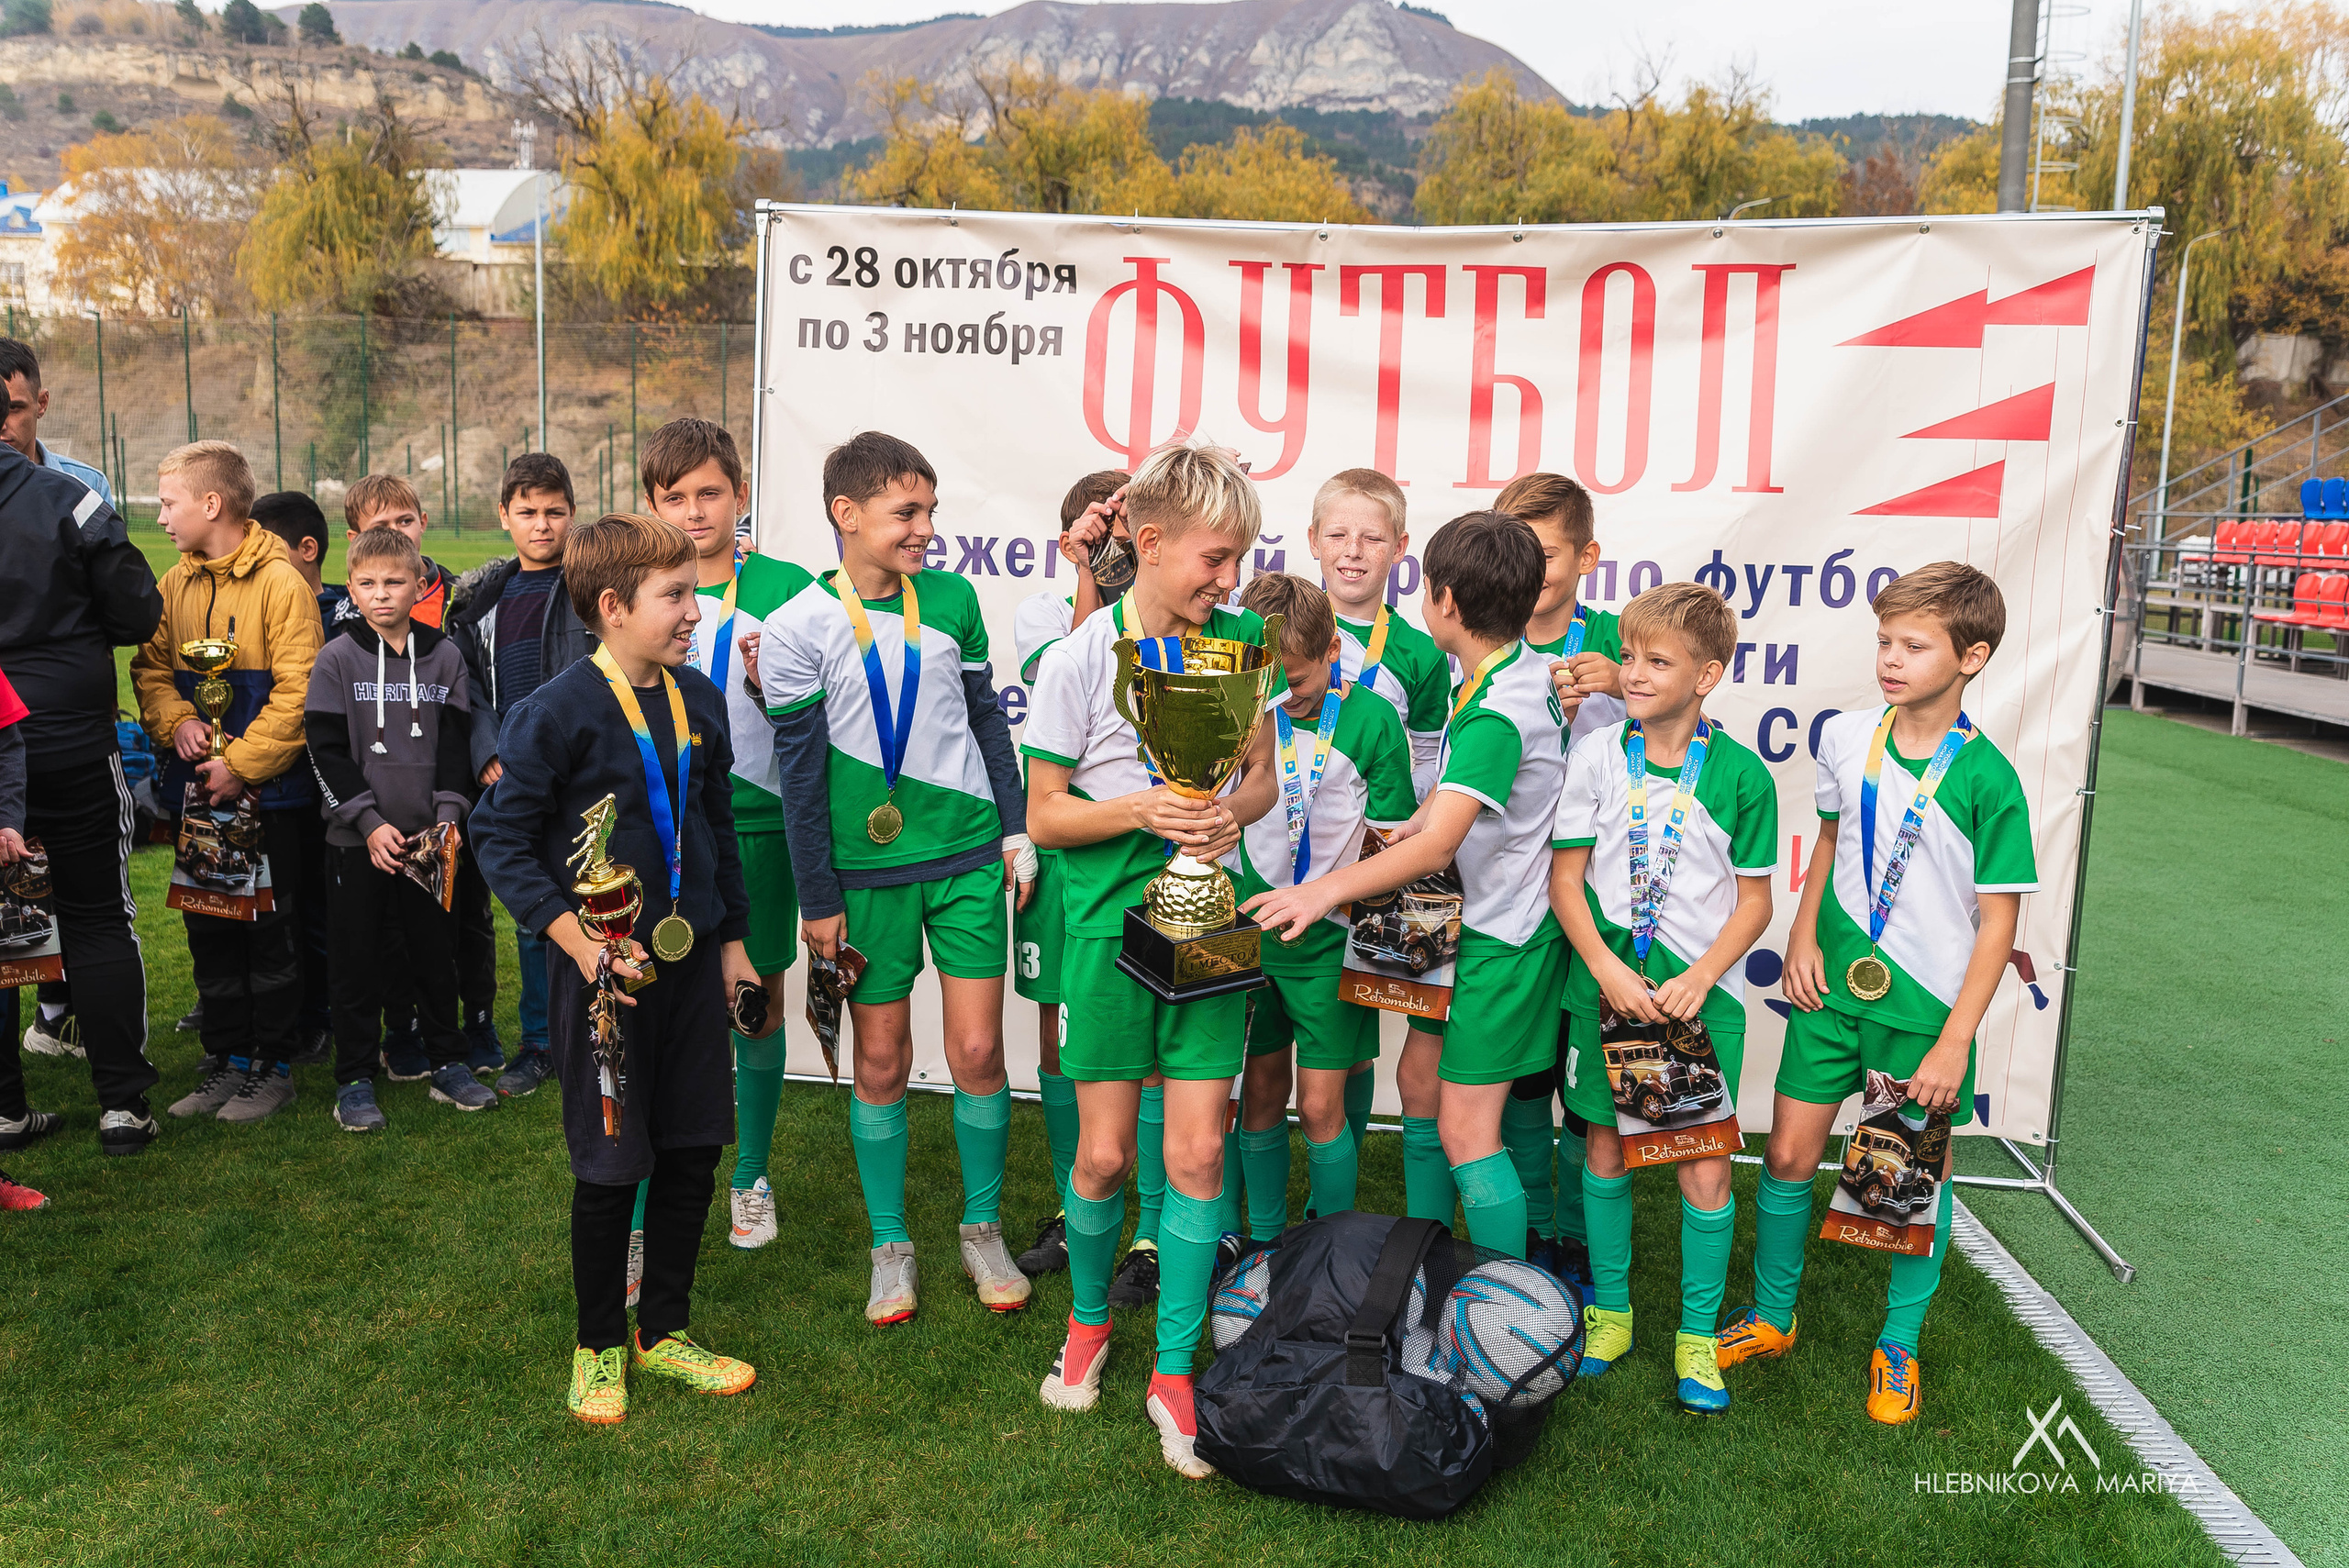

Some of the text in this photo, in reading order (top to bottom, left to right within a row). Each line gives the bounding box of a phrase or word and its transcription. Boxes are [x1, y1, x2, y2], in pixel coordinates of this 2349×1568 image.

[789, 245, 1077, 300] с 28 октября
[797, 311, 1063, 365] по 3 ноября
[1083, 255, 1798, 495] ФУТБОЛ
[1585, 560, 1663, 602] по
[1694, 548, 1899, 619] футбо
[179, 895, 243, 917] Retromobile
[1015, 940, 1041, 979] 13
[0, 968, 47, 985] omobile
[1353, 984, 1431, 1012] Retromobile
[1638, 1136, 1726, 1162] Retromobile
[1839, 1225, 1915, 1251] Retromobile
